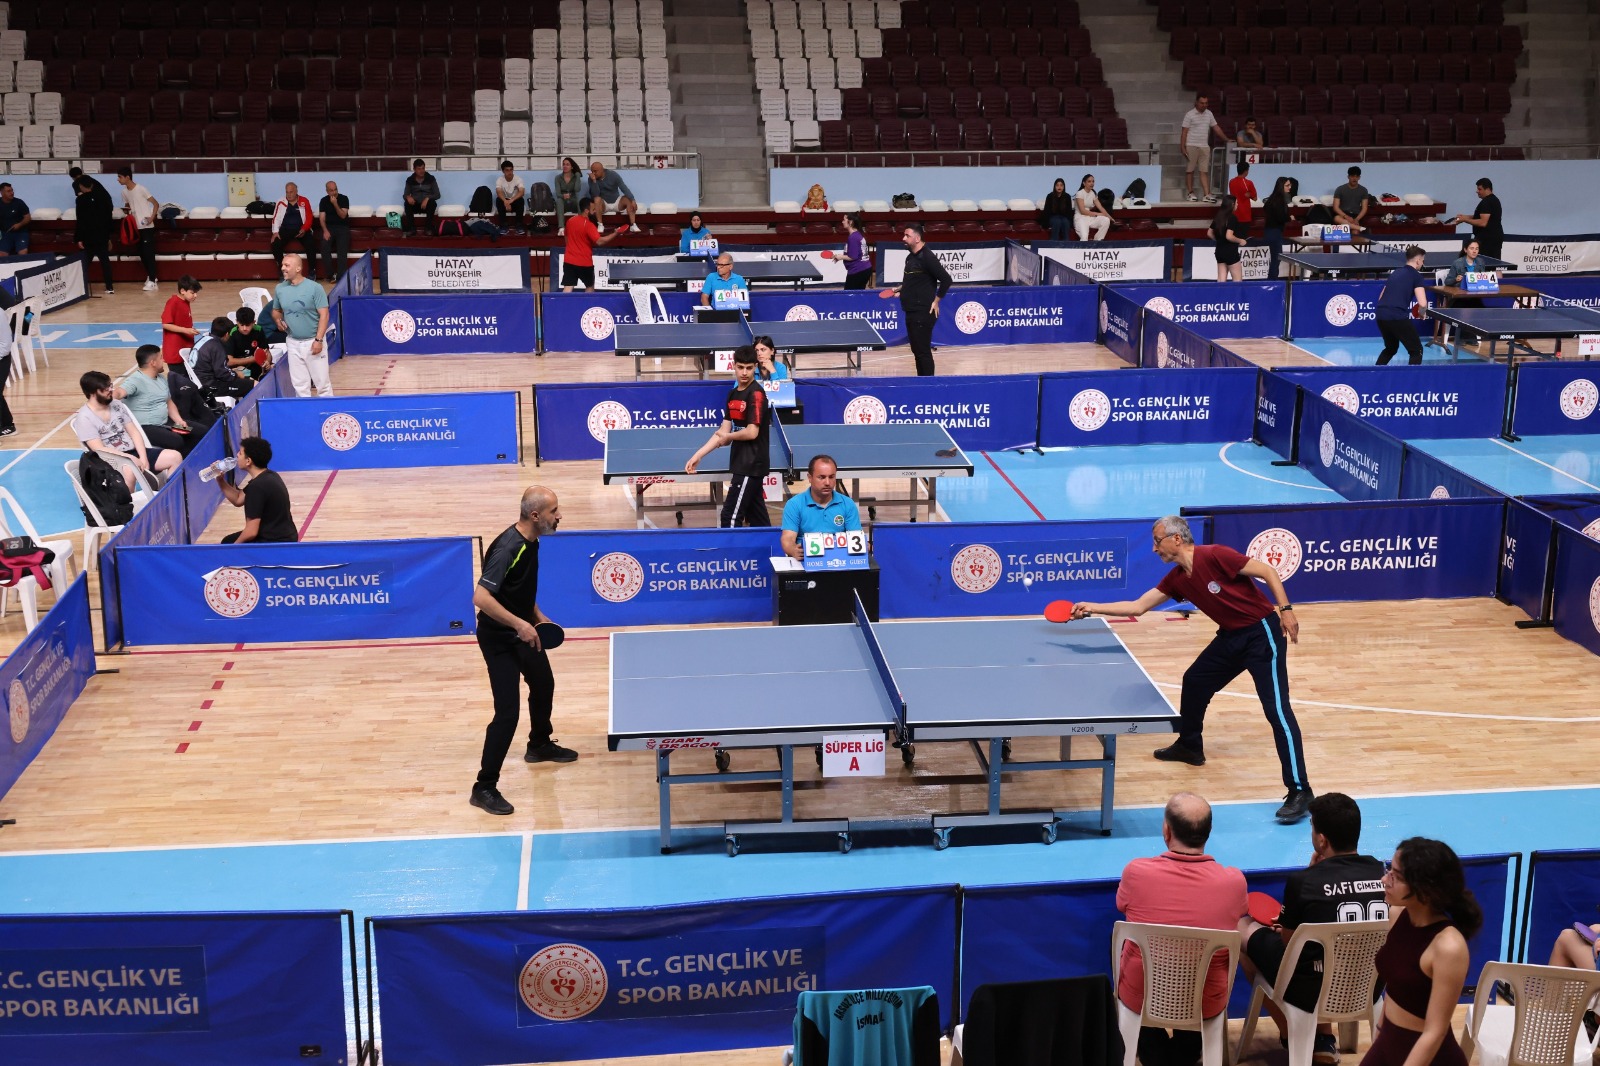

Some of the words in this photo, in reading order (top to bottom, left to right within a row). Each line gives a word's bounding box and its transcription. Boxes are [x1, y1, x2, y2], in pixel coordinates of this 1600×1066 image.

[1249, 155, 1255, 163] 4
[1083, 251, 1120, 260] HATAY
[1532, 245, 1567, 254] HATAY
[436, 259, 474, 269] HATAY
[1076, 262, 1126, 270] BÜYÜKŞEHİR
[1524, 255, 1571, 263] BÜYÜKŞEHİR
[428, 270, 482, 279] BÜYÜKŞEHİR
[1526, 263, 1569, 272] BELEDİYESİ
[431, 280, 479, 288] BELEDİYESİ
[1469, 274, 1475, 282] 5
[1490, 274, 1496, 283] 4
[717, 293, 724, 301] 4
[741, 292, 745, 300] 1
[1008, 306, 1048, 317] GENÇLİK
[1195, 302, 1235, 313] GENÇLİK
[416, 318, 434, 326] T.C.
[437, 315, 481, 327] GENÇLİK
[885, 311, 897, 319] VE
[1014, 317, 1063, 327] BAKANLIĞI
[1201, 312, 1249, 322] BAKANLIĞI
[445, 327, 498, 336] BAKANLIĞI
[1112, 398, 1134, 408] T.C.
[1138, 395, 1190, 410] GENÇLİK
[1195, 396, 1209, 406] VE
[1362, 394, 1382, 404] T.C.
[1387, 391, 1440, 406] GENÇLİK
[1444, 393, 1458, 403] VE
[633, 411, 656, 421] T.C.
[660, 407, 717, 422] GENÇLİK
[889, 405, 911, 415] T.C.
[915, 403, 970, 417] GENÇLİK
[974, 404, 989, 414] VE
[1112, 411, 1143, 422] SPOR
[1146, 409, 1209, 421] BAKANLIĞI
[1360, 407, 1391, 418] SPOR
[1394, 405, 1458, 416] BAKANLIĞI
[365, 420, 384, 430] T.C.
[387, 418, 433, 431] GENÇLİK
[435, 418, 448, 427] VE
[365, 433, 394, 443] SPOR
[397, 429, 455, 442] BAKANLIĞI
[1334, 454, 1348, 471] SPOR
[1346, 446, 1370, 469] GENÇLİK
[1371, 460, 1379, 474] VE
[810, 538, 820, 554] 5
[825, 537, 833, 546] 0
[838, 536, 846, 546] 0
[852, 536, 862, 552] 3
[1305, 541, 1334, 554] T.C.
[1340, 535, 1412, 555] GENÇLİK
[1417, 536, 1438, 549] VE
[1507, 535, 1516, 552] VE
[1008, 554, 1031, 565] T.C.
[1035, 550, 1094, 566] GENÇLİK
[1097, 551, 1114, 562] VE
[1304, 558, 1346, 572] SPOR
[1351, 553, 1436, 571] BAKANLIĞI
[649, 563, 674, 574] T.C.
[677, 559, 737, 576] GENÇLİK
[740, 560, 758, 571] VE
[1007, 572, 1043, 583] SPOR
[1047, 566, 1121, 581] BAKANLIĞI
[265, 577, 291, 589] T.C.
[294, 573, 358, 590] GENÇLİK
[360, 574, 380, 586] VE
[649, 580, 687, 591] SPOR
[690, 575, 767, 590] BAKANLIĞI
[265, 594, 306, 607] SPOR
[310, 590, 389, 605] BAKANLIĞI
[825, 742, 863, 754] SÜPER
[865, 739, 884, 753] LİG
[849, 757, 860, 771] A
[553, 959, 578, 967] GENÇLİK
[617, 959, 658, 978] T.C.
[666, 947, 769, 975] GENÇLİK
[773, 949, 802, 966] VE
[38, 966, 145, 991] GENÇLİK
[149, 969, 181, 986] VE
[618, 985, 684, 1004] SPOR
[689, 972, 817, 1000] BAKANLIĞI
[64, 993, 198, 1015] BAKANLIĞI
